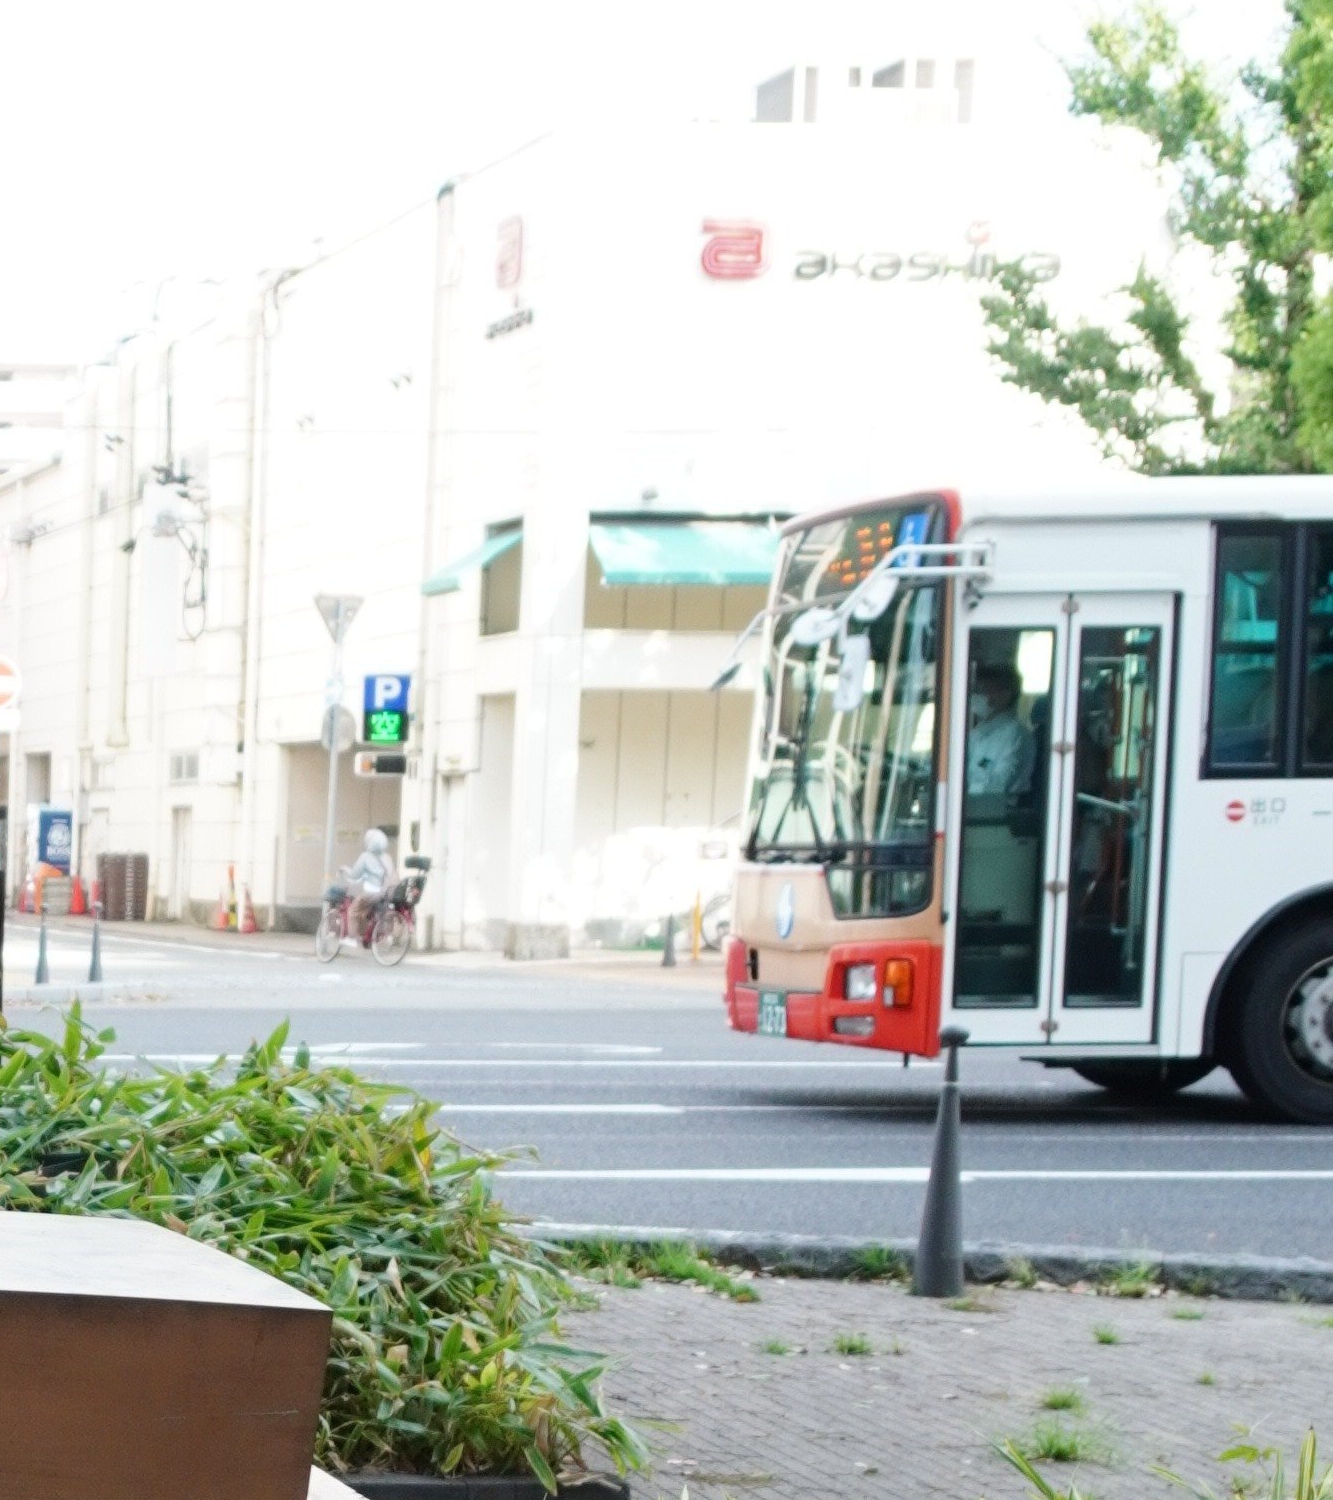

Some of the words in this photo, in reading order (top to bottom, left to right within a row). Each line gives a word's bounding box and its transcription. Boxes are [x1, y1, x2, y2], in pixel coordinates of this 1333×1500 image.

[375, 677, 402, 708] P
[370, 711, 401, 741] 空
[1251, 799, 1285, 813] 出口
